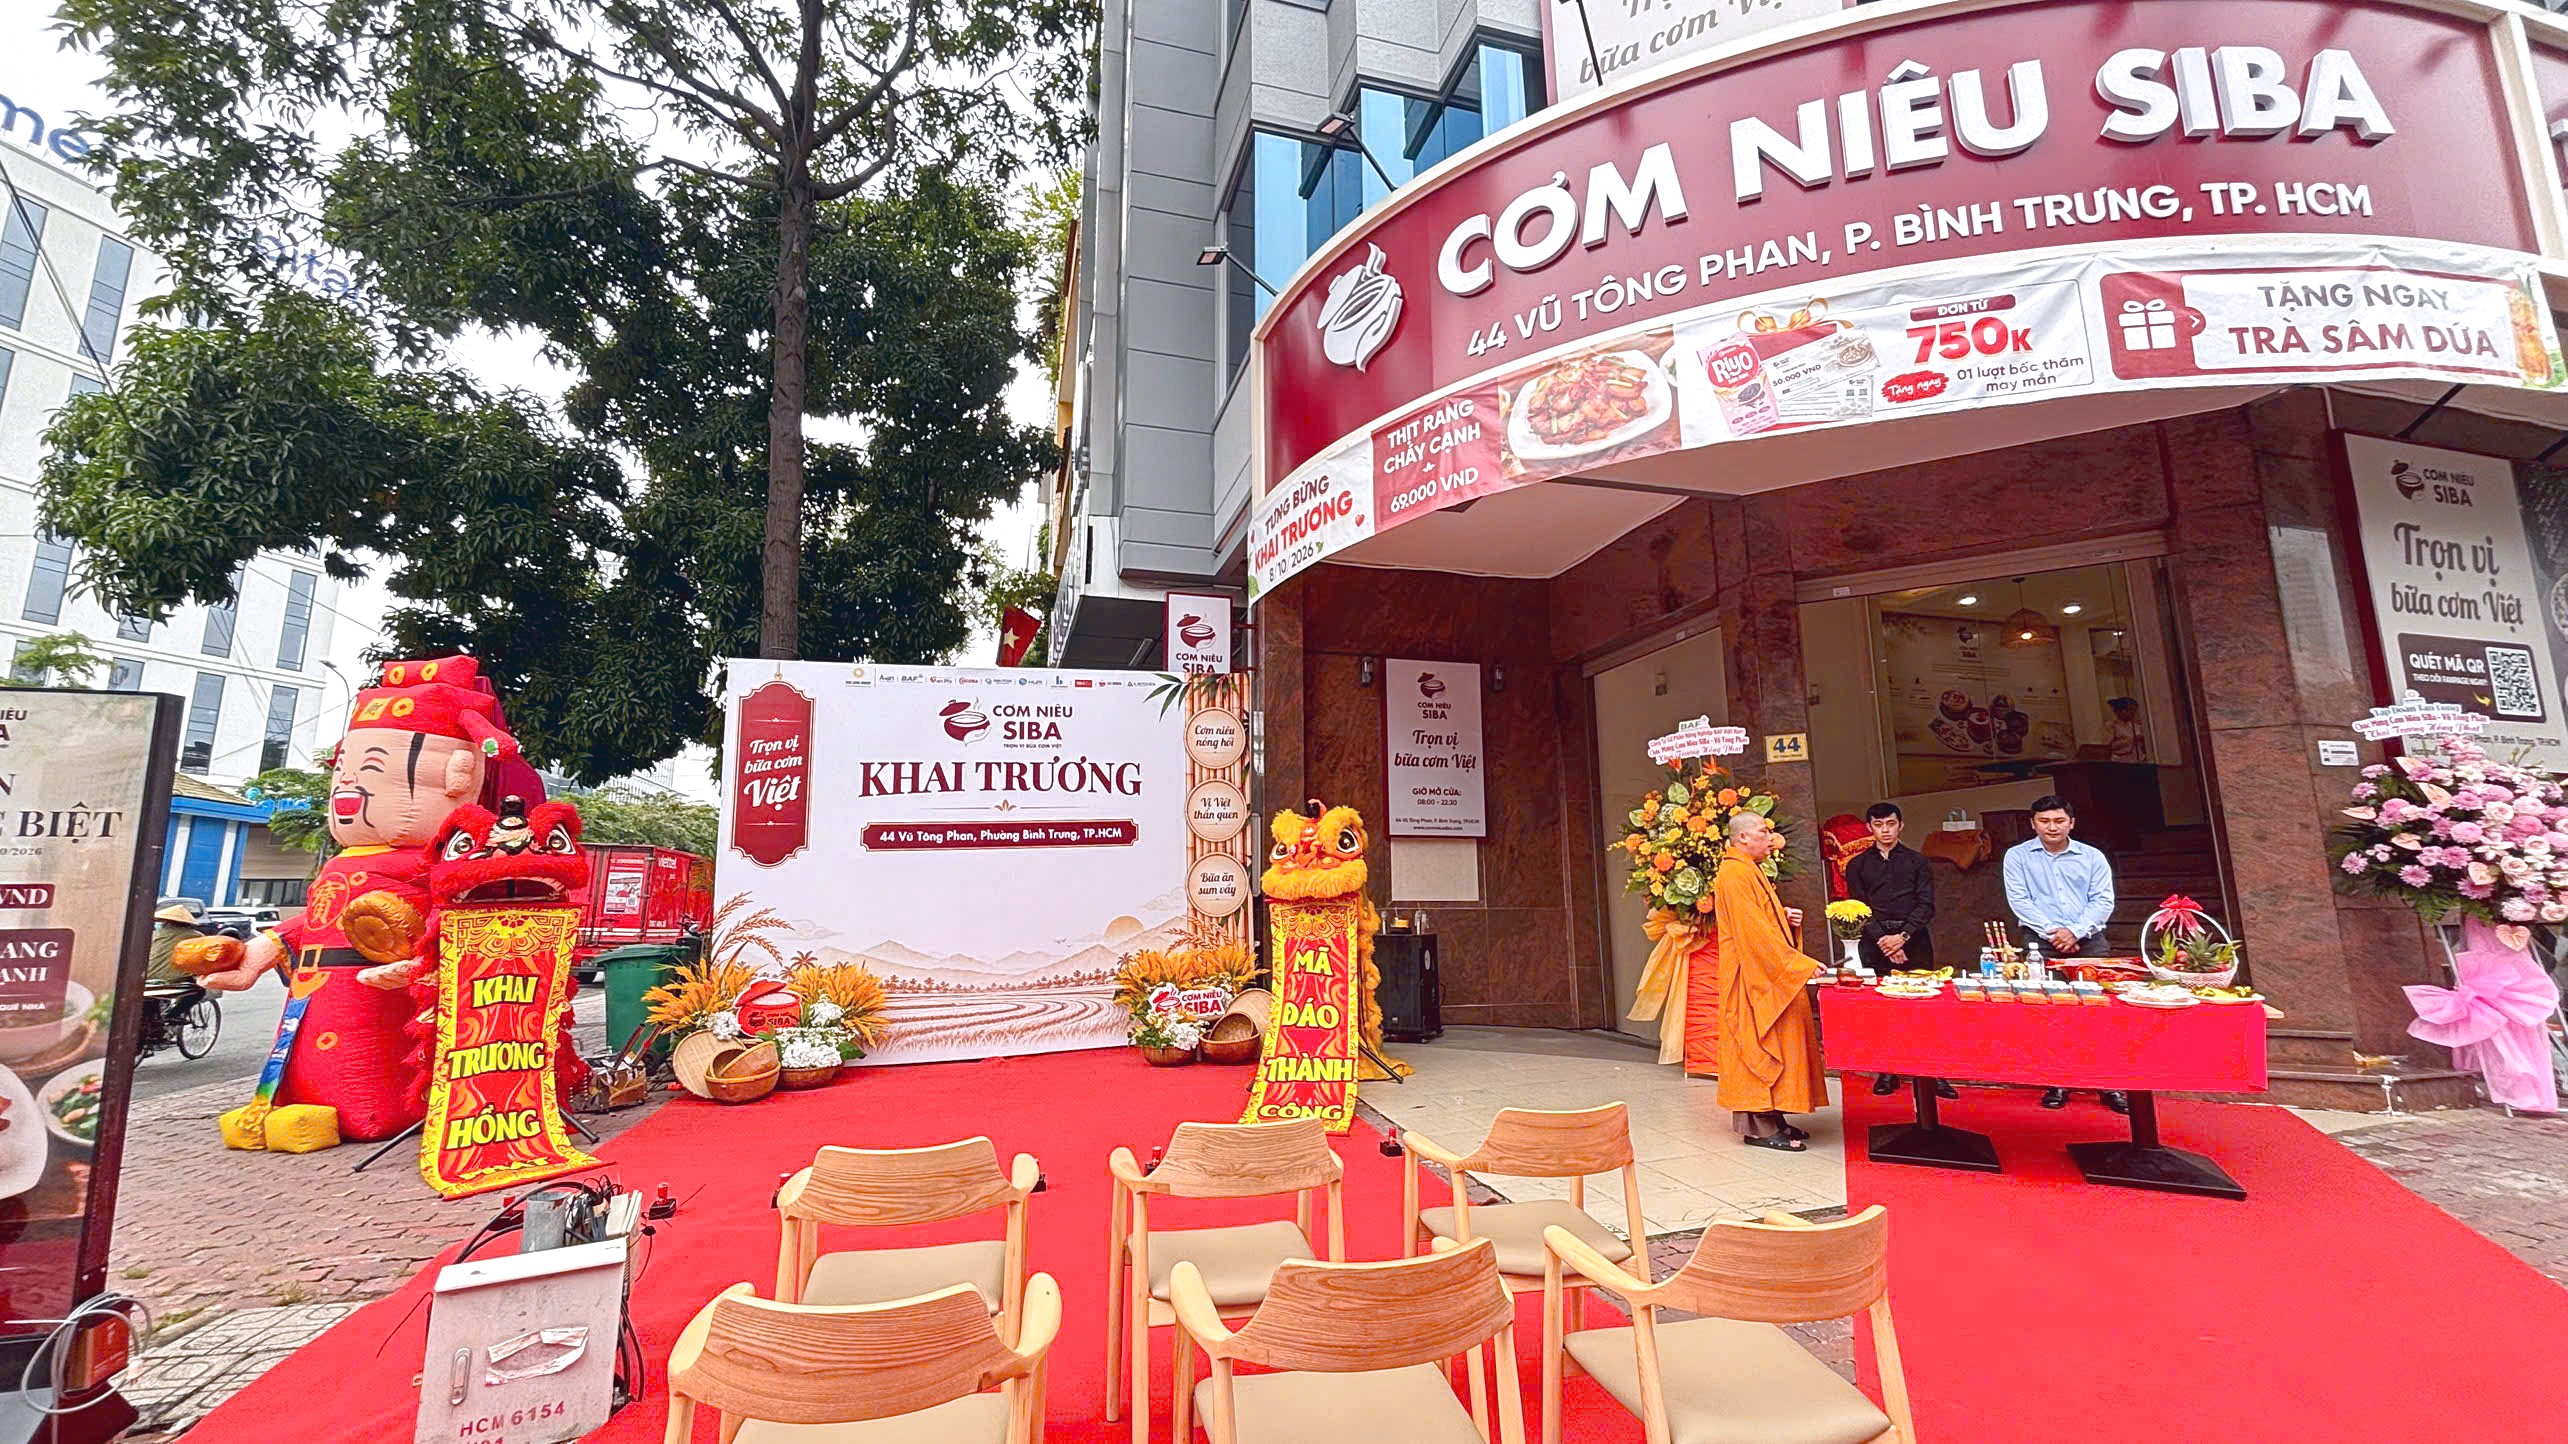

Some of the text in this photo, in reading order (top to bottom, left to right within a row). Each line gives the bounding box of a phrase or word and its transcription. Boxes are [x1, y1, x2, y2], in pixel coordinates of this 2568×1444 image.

[1649, 8, 1719, 54] cơm
[1437, 45, 2397, 298] CƠM NIÊU SIBA
[1466, 181, 2374, 358] 44 VŨ TÔNG PHAN, P. BÌNH TRƯNG, TP. HCM
[1937, 298, 1989, 316] ĐƠN TỪ
[2257, 280, 2450, 313] TẶNG NGAY
[1905, 316, 2033, 365] 750K
[2228, 317, 2311, 355] TRÀ
[2322, 319, 2415, 354] SÂM
[1802, 363, 1822, 376] VND
[1957, 356, 2084, 380] 01 lượt bốc thăm
[1986, 371, 2057, 392] may mắn
[1386, 399, 1476, 449] THỊT RANG
[1383, 421, 1482, 474] CHÁY CẠNH
[1390, 466, 1479, 513] 69.000 VND
[2433, 484, 2473, 507] SIBA
[1255, 489, 1354, 575] KHAI TRƯƠNG
[2393, 521, 2500, 588] Trọn vị
[2390, 581, 2525, 633] bữa cơm Việt
[1182, 662, 1216, 673] SIBA
[1200, 652, 1223, 663] NIÊU
[2409, 651, 2486, 674] QUÉT MÃ QR
[992, 703, 1073, 718] CƠM NIÊU
[1422, 709, 1448, 720] SIBA
[1002, 720, 1063, 741] SIBA
[1194, 724, 1236, 736] Cơm niêu
[1680, 721, 1700, 730] BAF
[749, 734, 800, 756] Trọn vị
[1195, 736, 1219, 750] nóng
[1412, 729, 1460, 750] Trọn vị
[1773, 736, 1801, 752] 44
[743, 755, 803, 775] bữa cơm
[1394, 752, 1477, 773] bữa cơm Việt
[857, 755, 1143, 798] KHAI TRƯƠNG
[742, 774, 802, 812] Việt
[1213, 796, 1231, 810] Việt
[1417, 798, 1435, 806] 08:00
[16, 801, 123, 844] BIỆT
[879, 831, 896, 842] 44
[898, 831, 914, 842] Vũ
[917, 830, 944, 844] Tông
[946, 829, 977, 842] Phan,
[1083, 827, 1122, 839] TP.HCM
[1200, 871, 1235, 883] Bữa ăn
[1197, 887, 1218, 895] sum
[1293, 945, 1334, 976] MÃ
[472, 974, 539, 1009] KHAI
[1181, 989, 1223, 1002] CƠM NIÊU
[1184, 999, 1222, 1014] SIBA
[1281, 998, 1341, 1029] ĐÁO
[446, 1040, 546, 1080] TRƯƠNG
[1266, 1052, 1354, 1082] THÀNH
[1258, 1102, 1343, 1120] CÔNG
[445, 1104, 541, 1150] HỒNG
[459, 1400, 566, 1438] HCM 6154
